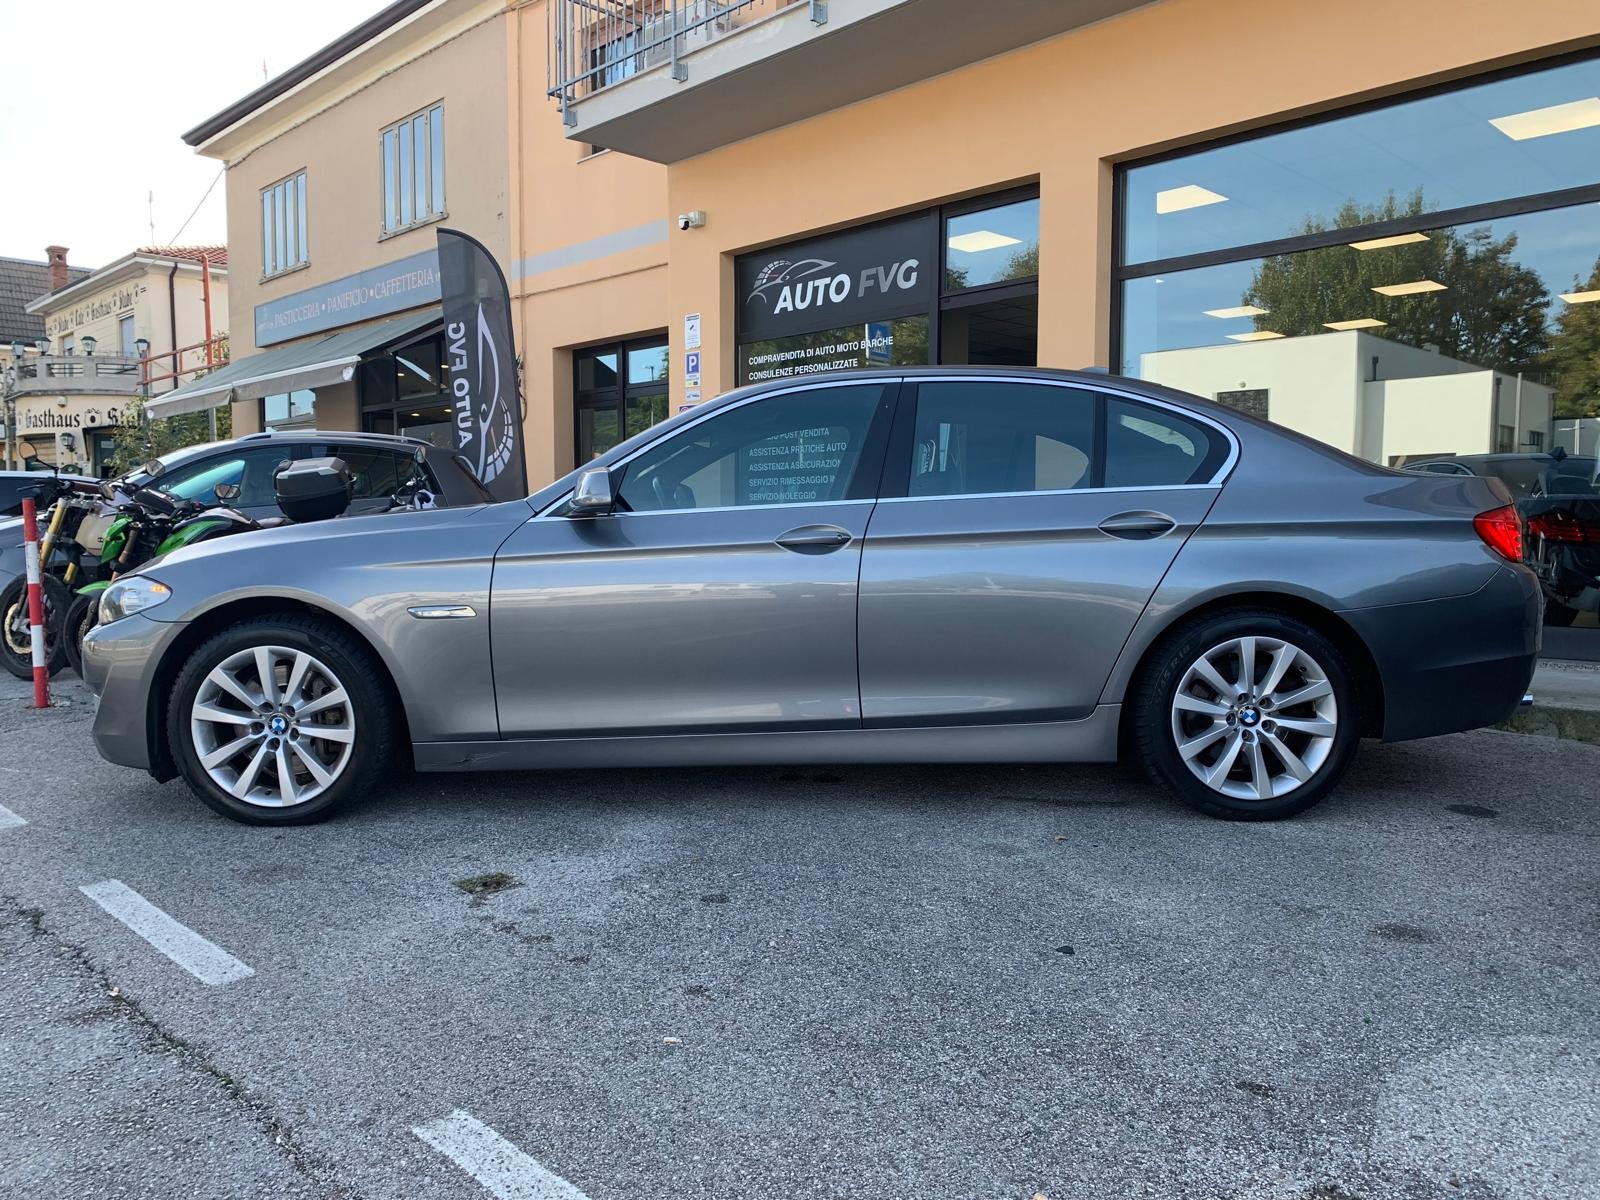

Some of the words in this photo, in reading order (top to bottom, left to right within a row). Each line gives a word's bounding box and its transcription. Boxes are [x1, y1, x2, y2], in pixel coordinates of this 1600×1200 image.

[327, 287, 368, 313] PANIFICIO
[374, 267, 434, 299] CAFFETTERIA
[773, 273, 851, 315] AUTO
[857, 258, 920, 298] FVG
[748, 350, 806, 366] COMPRAVENDITA
[806, 348, 814, 357] DI
[815, 345, 835, 356] AUTO
[836, 341, 859, 353] MOTO
[860, 336, 894, 349] BARCHE
[748, 367, 794, 380] CONSULENZE
[794, 358, 858, 375] PERSONALIZZATE
[799, 427, 829, 437] VENDITA
[749, 446, 790, 457] ASSISTENZA
[790, 443, 825, 454] PRATICHE
[826, 442, 847, 452] AUTO
[749, 462, 790, 472] ASSISTENZA
[749, 478, 779, 487] SERVIZIO
[780, 475, 828, 485] RIMESSAGGIO
[749, 492, 779, 501] SERVIZIO
[780, 491, 817, 500] NOLEGGIO
